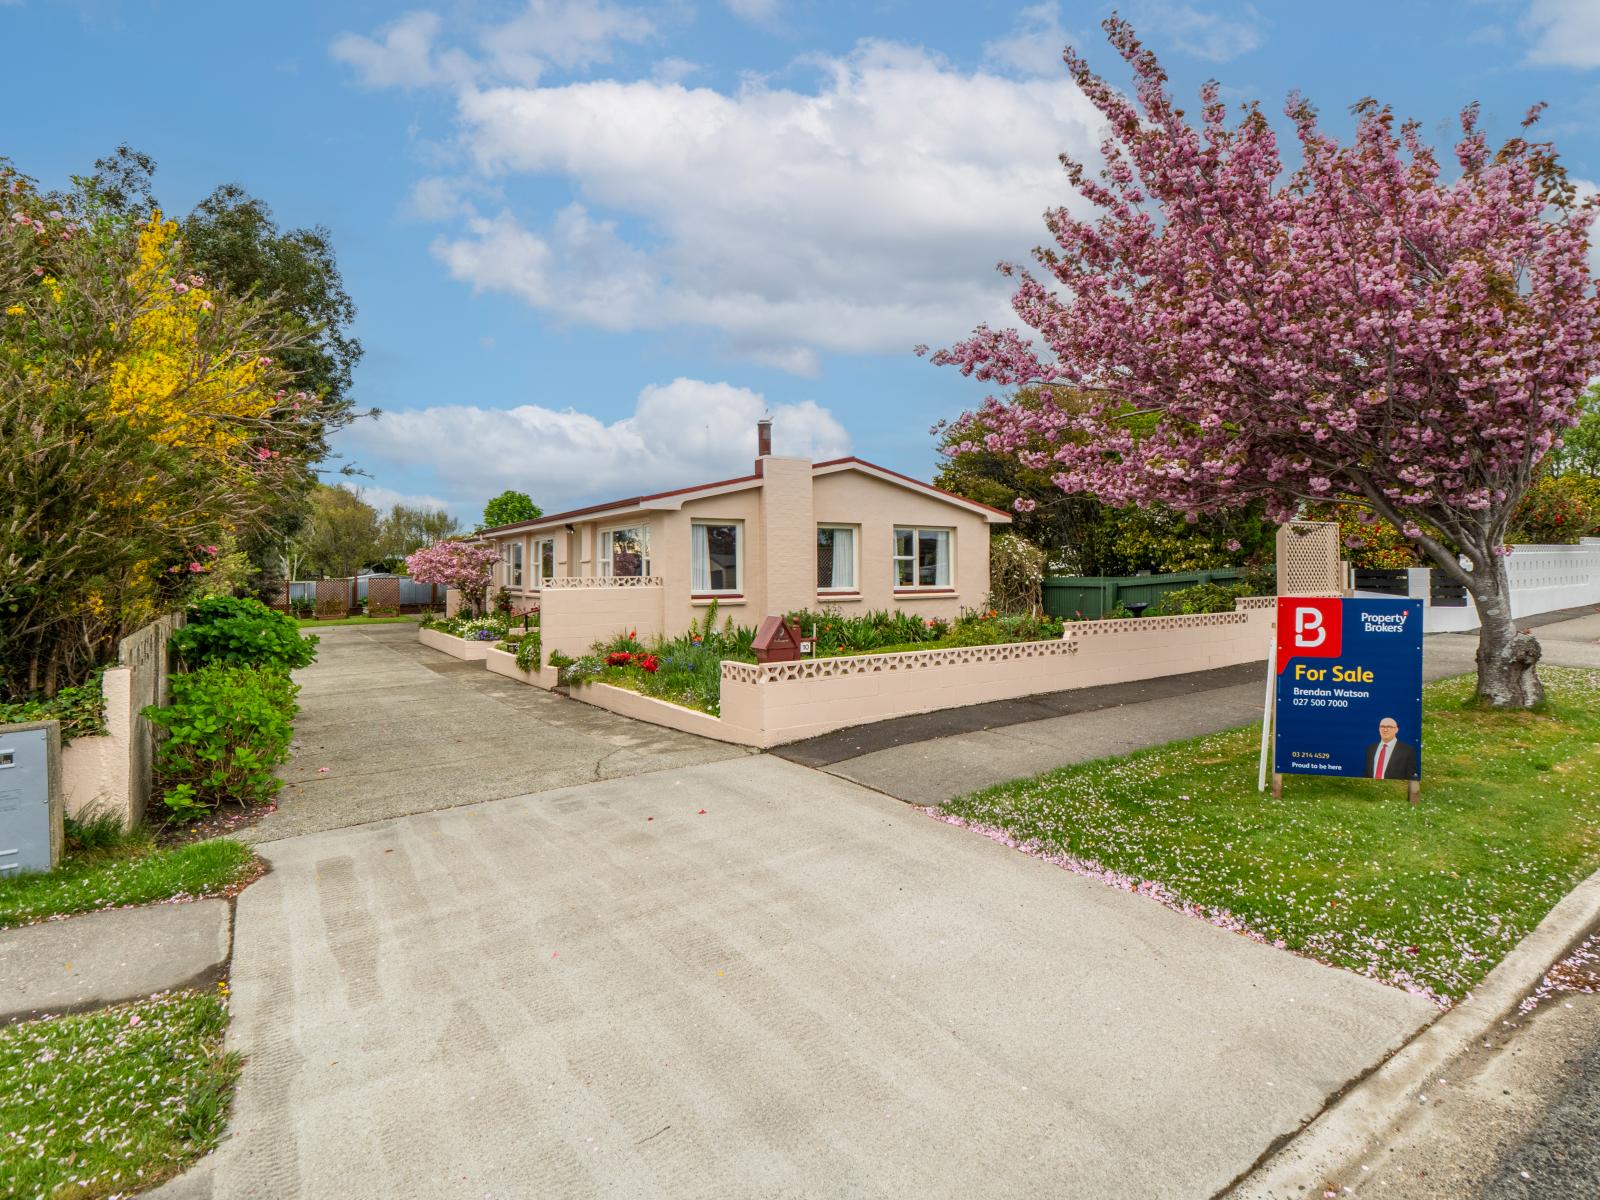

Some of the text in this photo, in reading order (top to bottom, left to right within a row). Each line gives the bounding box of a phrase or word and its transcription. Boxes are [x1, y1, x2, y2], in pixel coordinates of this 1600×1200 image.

[1361, 612, 1407, 625] Property
[1295, 607, 1326, 647] B
[1365, 622, 1403, 633] Brokers
[1295, 664, 1374, 683] For Sale
[1293, 687, 1369, 698] Brendan Watson
[1293, 698, 1348, 708] 027 500 7000
